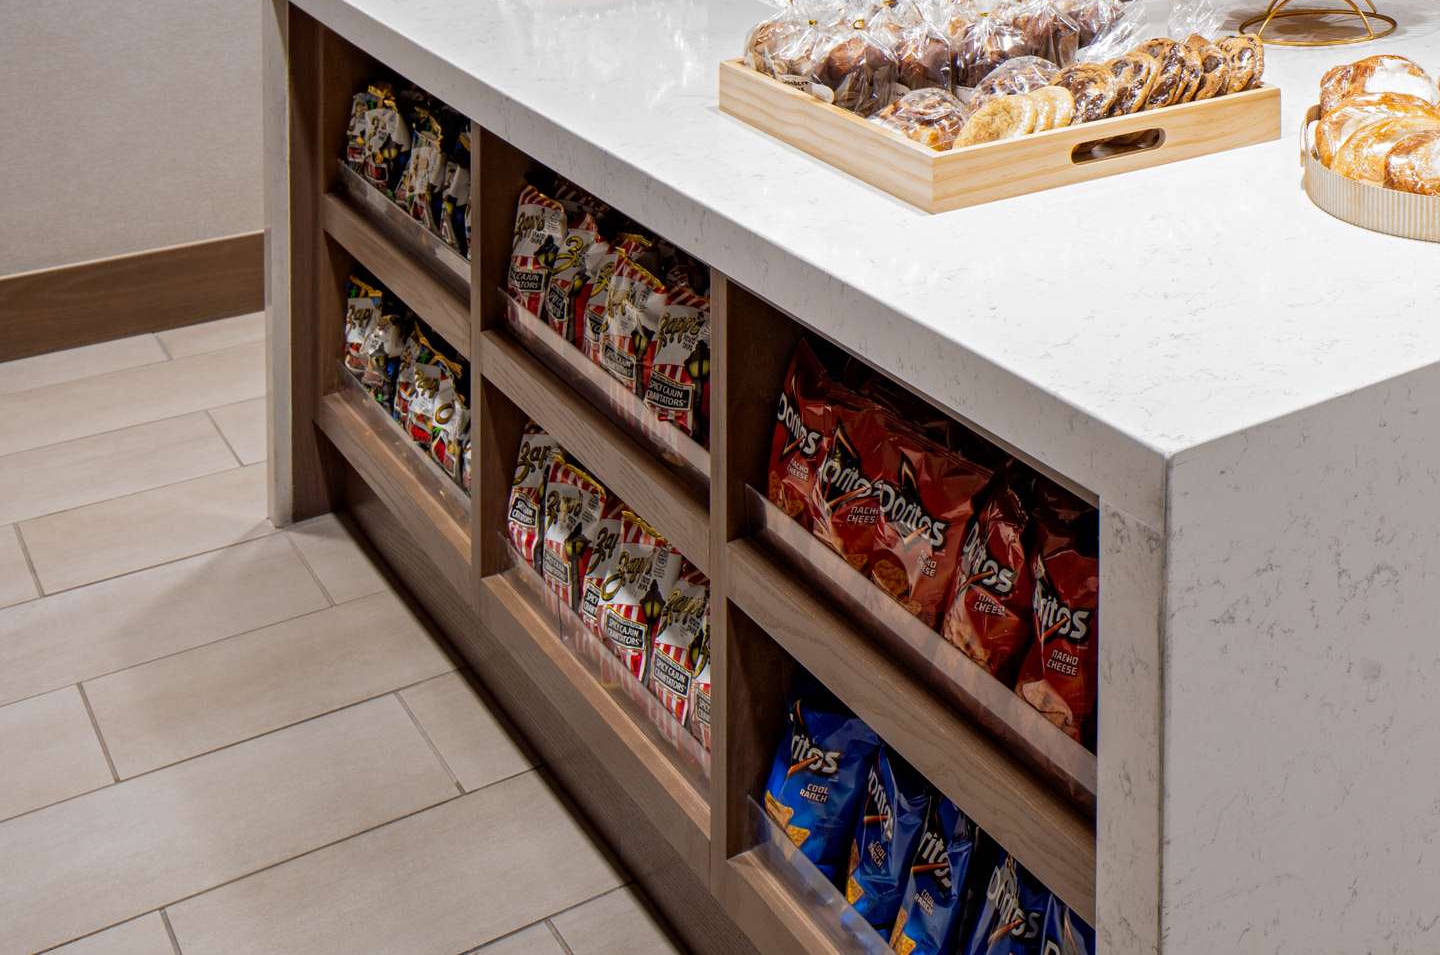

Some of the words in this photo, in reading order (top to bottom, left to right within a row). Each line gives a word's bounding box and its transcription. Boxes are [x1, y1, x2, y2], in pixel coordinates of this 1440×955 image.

[661, 384, 684, 399] CAJUN
[777, 392, 821, 456] Doritos
[879, 483, 946, 547] Doritos
[1036, 594, 1090, 639] ritos
[1047, 658, 1078, 676] CHEESE
[1052, 649, 1079, 666] NACHO
[790, 733, 841, 774] ritos
[799, 789, 828, 804] RANCH
[807, 782, 830, 795] COOL
[917, 831, 952, 889] ritos
